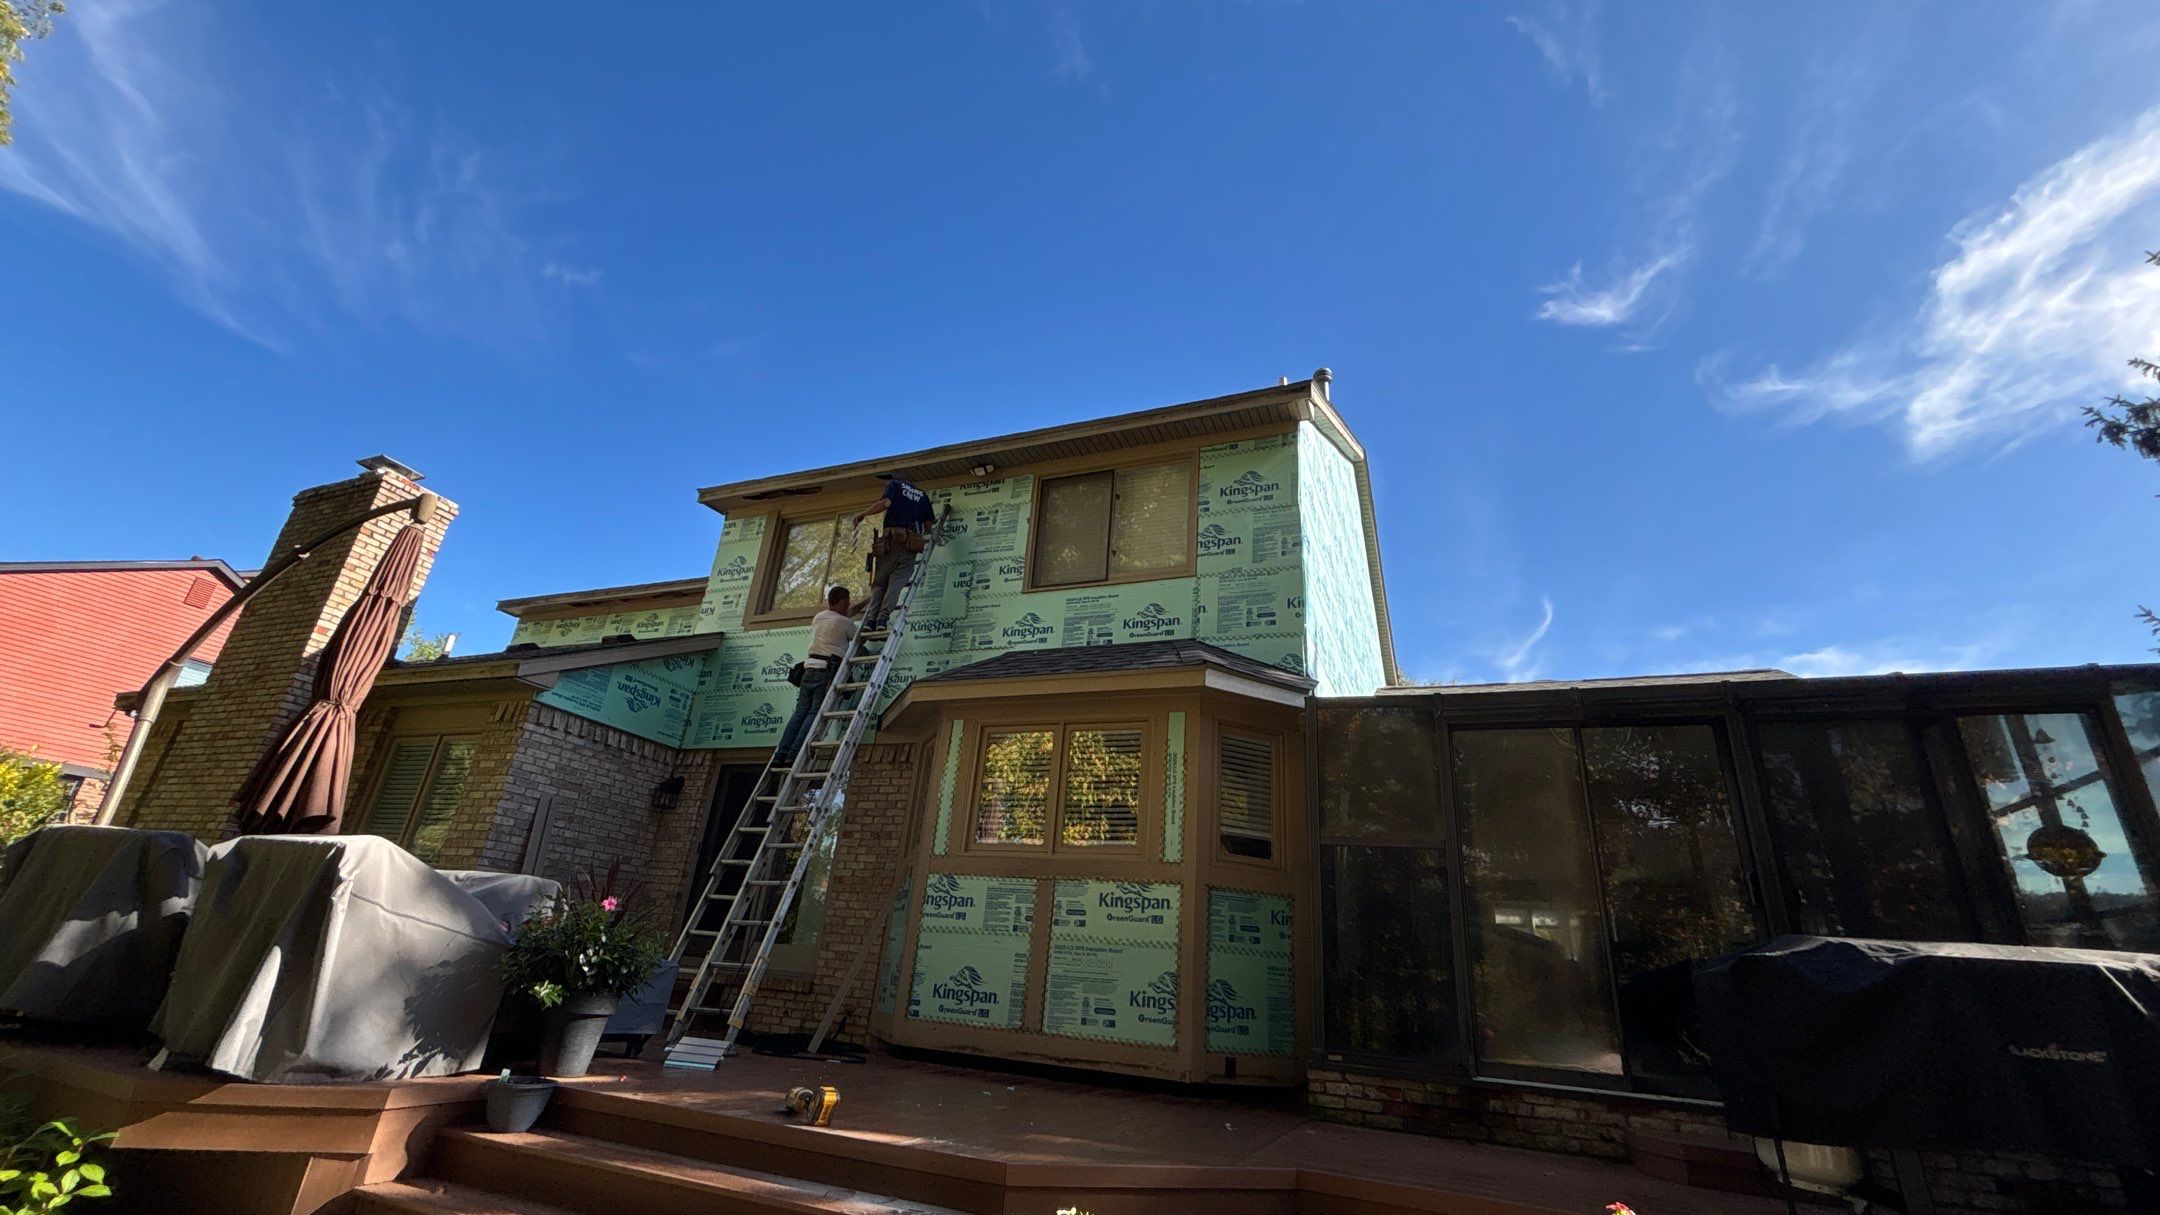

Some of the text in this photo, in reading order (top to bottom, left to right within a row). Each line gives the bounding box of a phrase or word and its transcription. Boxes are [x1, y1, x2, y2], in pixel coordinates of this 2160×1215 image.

[902, 489, 921, 503] CREW
[1220, 482, 1279, 498] Kingspan
[717, 565, 754, 577] Kingspan
[1123, 617, 1181, 631] Kingspan
[1002, 625, 1054, 639] Kingspan
[617, 681, 661, 707] Kingspan
[741, 716, 783, 728] Kingspan
[926, 894, 974, 910] ngspan
[1099, 891, 1171, 913] Kingspan
[1107, 913, 1149, 923] GreenGuard
[932, 983, 997, 1007] Kingspan
[1129, 990, 1175, 1015] Kings
[938, 1004, 976, 1016] GreenGuard
